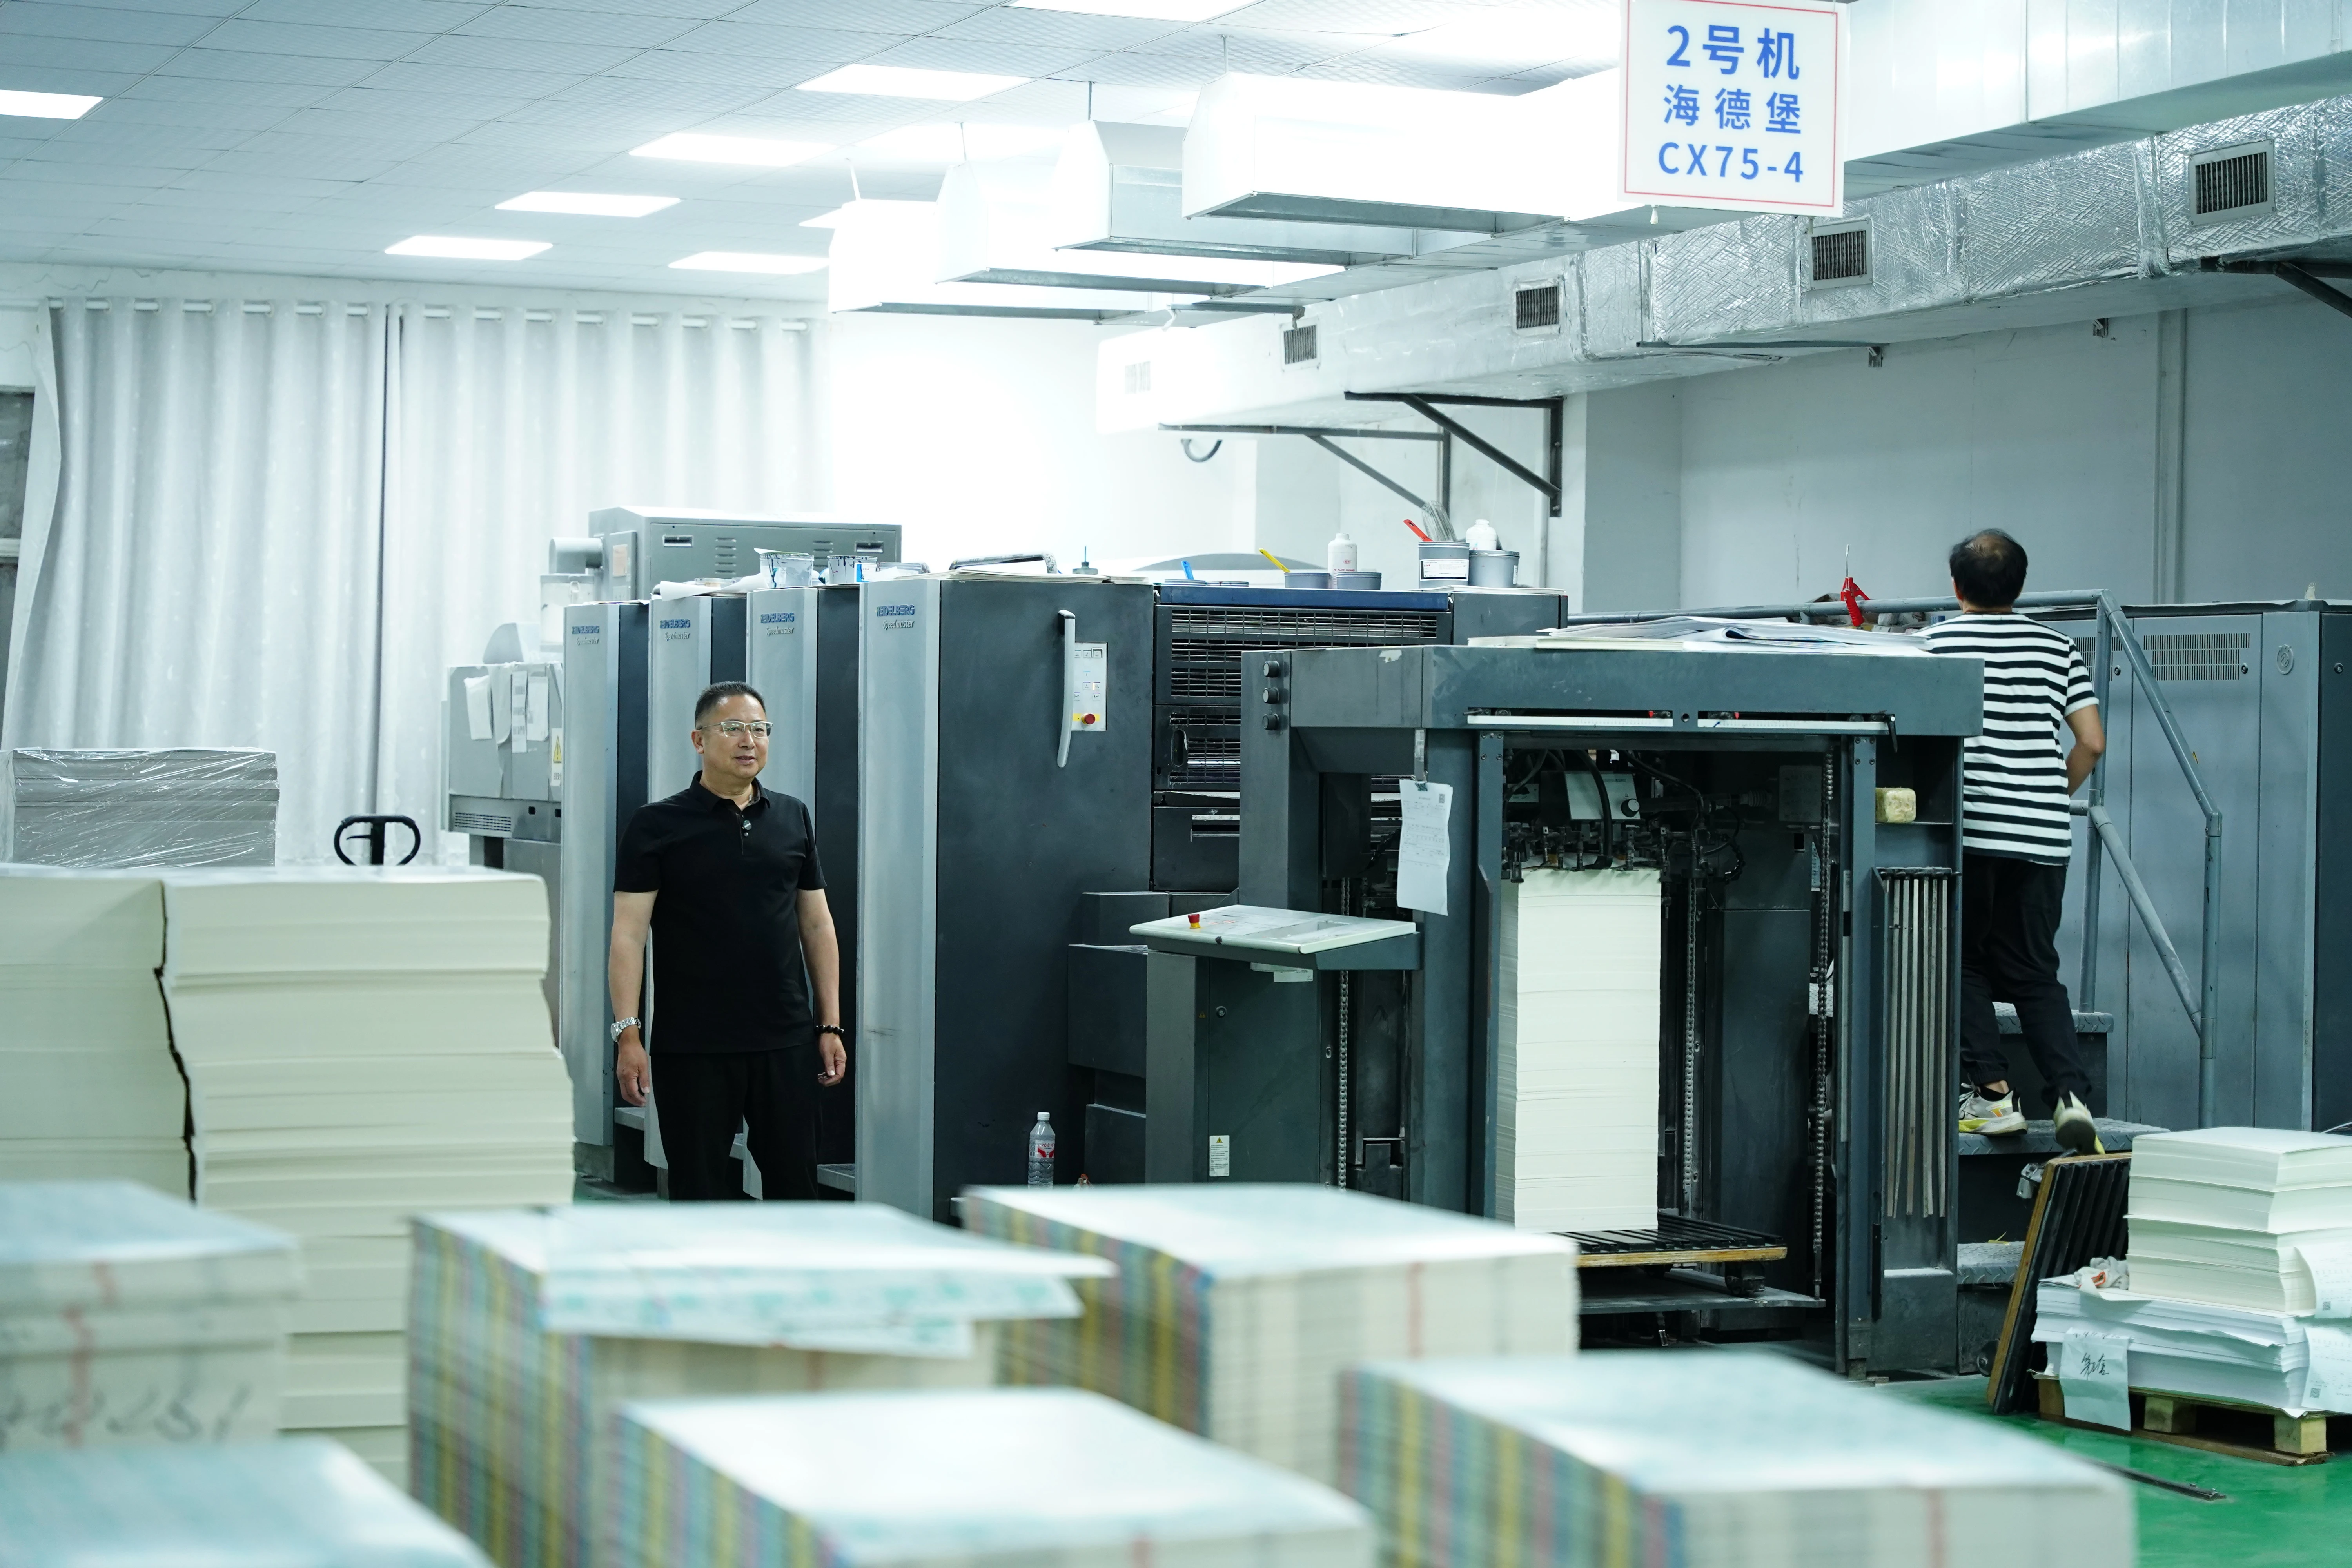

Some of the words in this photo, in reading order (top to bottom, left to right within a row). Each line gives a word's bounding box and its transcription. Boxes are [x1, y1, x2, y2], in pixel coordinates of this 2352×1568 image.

[1666, 24, 1800, 80] 2号机
[1663, 84, 1802, 134] 海德堡
[1658, 142, 1804, 183] CX75-4
[875, 605, 915, 617] HEIDELBERG
[760, 613, 794, 623] HEIDELBERG
[883, 620, 915, 630] Speedmaster
[665, 632, 690, 641] Speedmaster
[766, 626, 794, 637] Speedmaster
